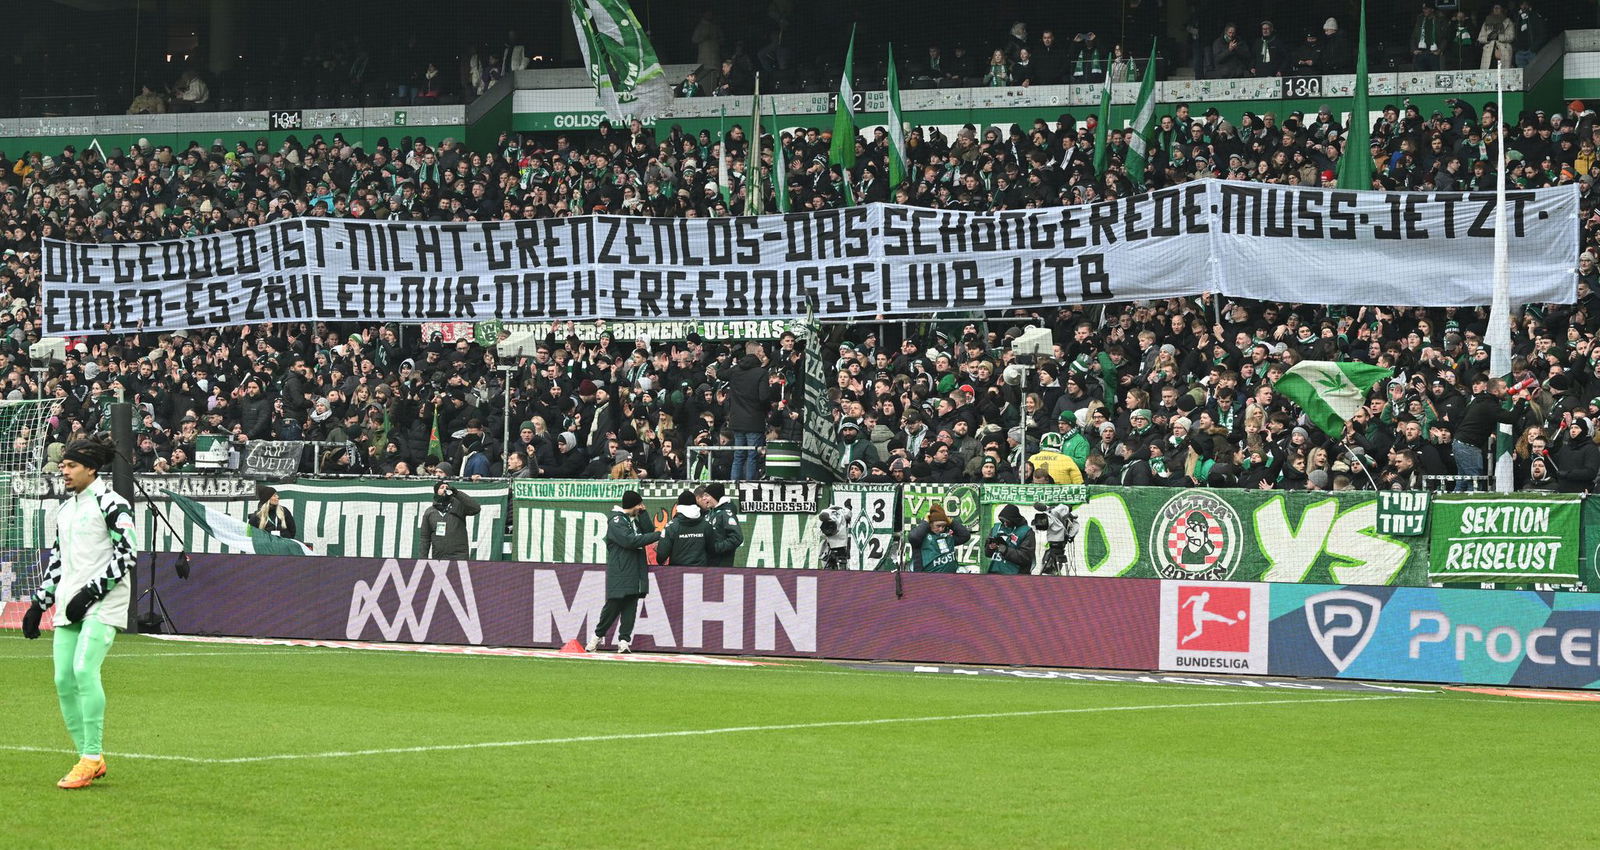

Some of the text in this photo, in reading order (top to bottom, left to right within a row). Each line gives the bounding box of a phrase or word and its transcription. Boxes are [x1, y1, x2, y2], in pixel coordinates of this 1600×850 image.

[1285, 78, 1320, 97] 130
[831, 93, 862, 111] 12
[45, 242, 100, 284] DIE
[113, 228, 262, 283] GEDULD
[271, 219, 330, 271] IST
[344, 222, 466, 272] NICHT
[784, 208, 869, 262] DAS
[1220, 184, 1357, 240] MUSS
[240, 273, 387, 321] ZÄHLEN
[399, 275, 480, 319] NUR
[494, 270, 597, 319] NOCH
[1012, 254, 1114, 305] UTB
[612, 321, 685, 341] BREMEN
[703, 320, 785, 341] ULTRAS
[246, 442, 295, 470] CIVETTA
[132, 479, 255, 496] NBREAKABLE
[516, 483, 555, 497] SEKTION
[741, 501, 816, 512] UNVERGESSEN
[872, 498, 885, 522] 3
[1379, 491, 1428, 511] תמיד
[1460, 506, 1551, 534] SEKTION
[517, 507, 608, 564] ULTR
[868, 538, 884, 559] 2
[1445, 541, 1562, 570] REISELUST
[533, 569, 818, 652] MAHN
[1409, 610, 1600, 667] Proce
[1176, 656, 1249, 669] BUNDESLIGA
